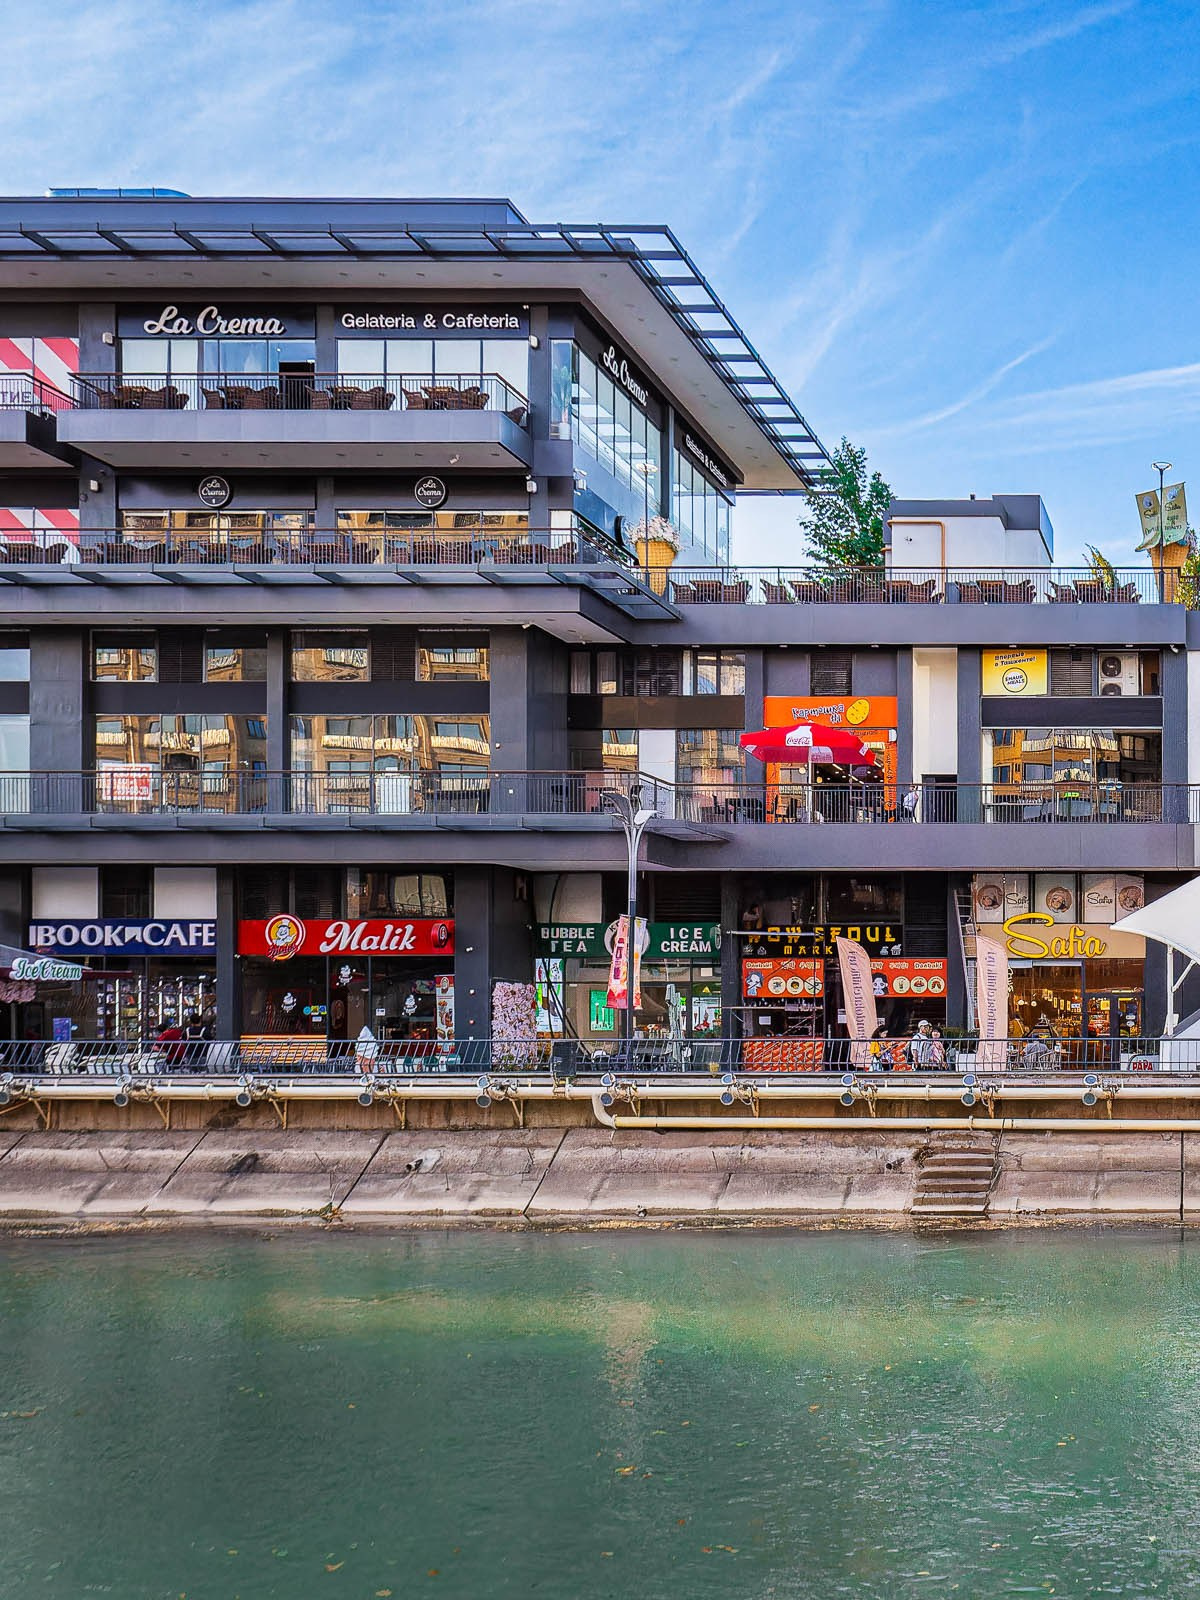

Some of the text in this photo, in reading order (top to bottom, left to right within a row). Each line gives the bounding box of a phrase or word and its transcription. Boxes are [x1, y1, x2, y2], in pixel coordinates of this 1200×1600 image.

[143, 305, 285, 335] La Crema
[341, 313, 519, 328] Gelateria & Cafeteria
[602, 345, 648, 407] La Crema
[207, 479, 220, 488] La
[423, 479, 436, 488] La
[201, 486, 226, 496] Crema
[417, 486, 442, 496] Crema
[142, 923, 215, 947] CAFE
[319, 921, 418, 953] Malik
[540, 927, 595, 939] BUBBLE
[670, 927, 703, 939] ICE
[748, 926, 896, 943] WOW SEOUL
[1002, 912, 1107, 958] Safia
[550, 940, 587, 953] TEA
[660, 940, 712, 953] CREAM
[783, 945, 833, 955] MARK
[15, 958, 82, 979] Ice Cream
[1132, 1060, 1153, 1071] PAPA
